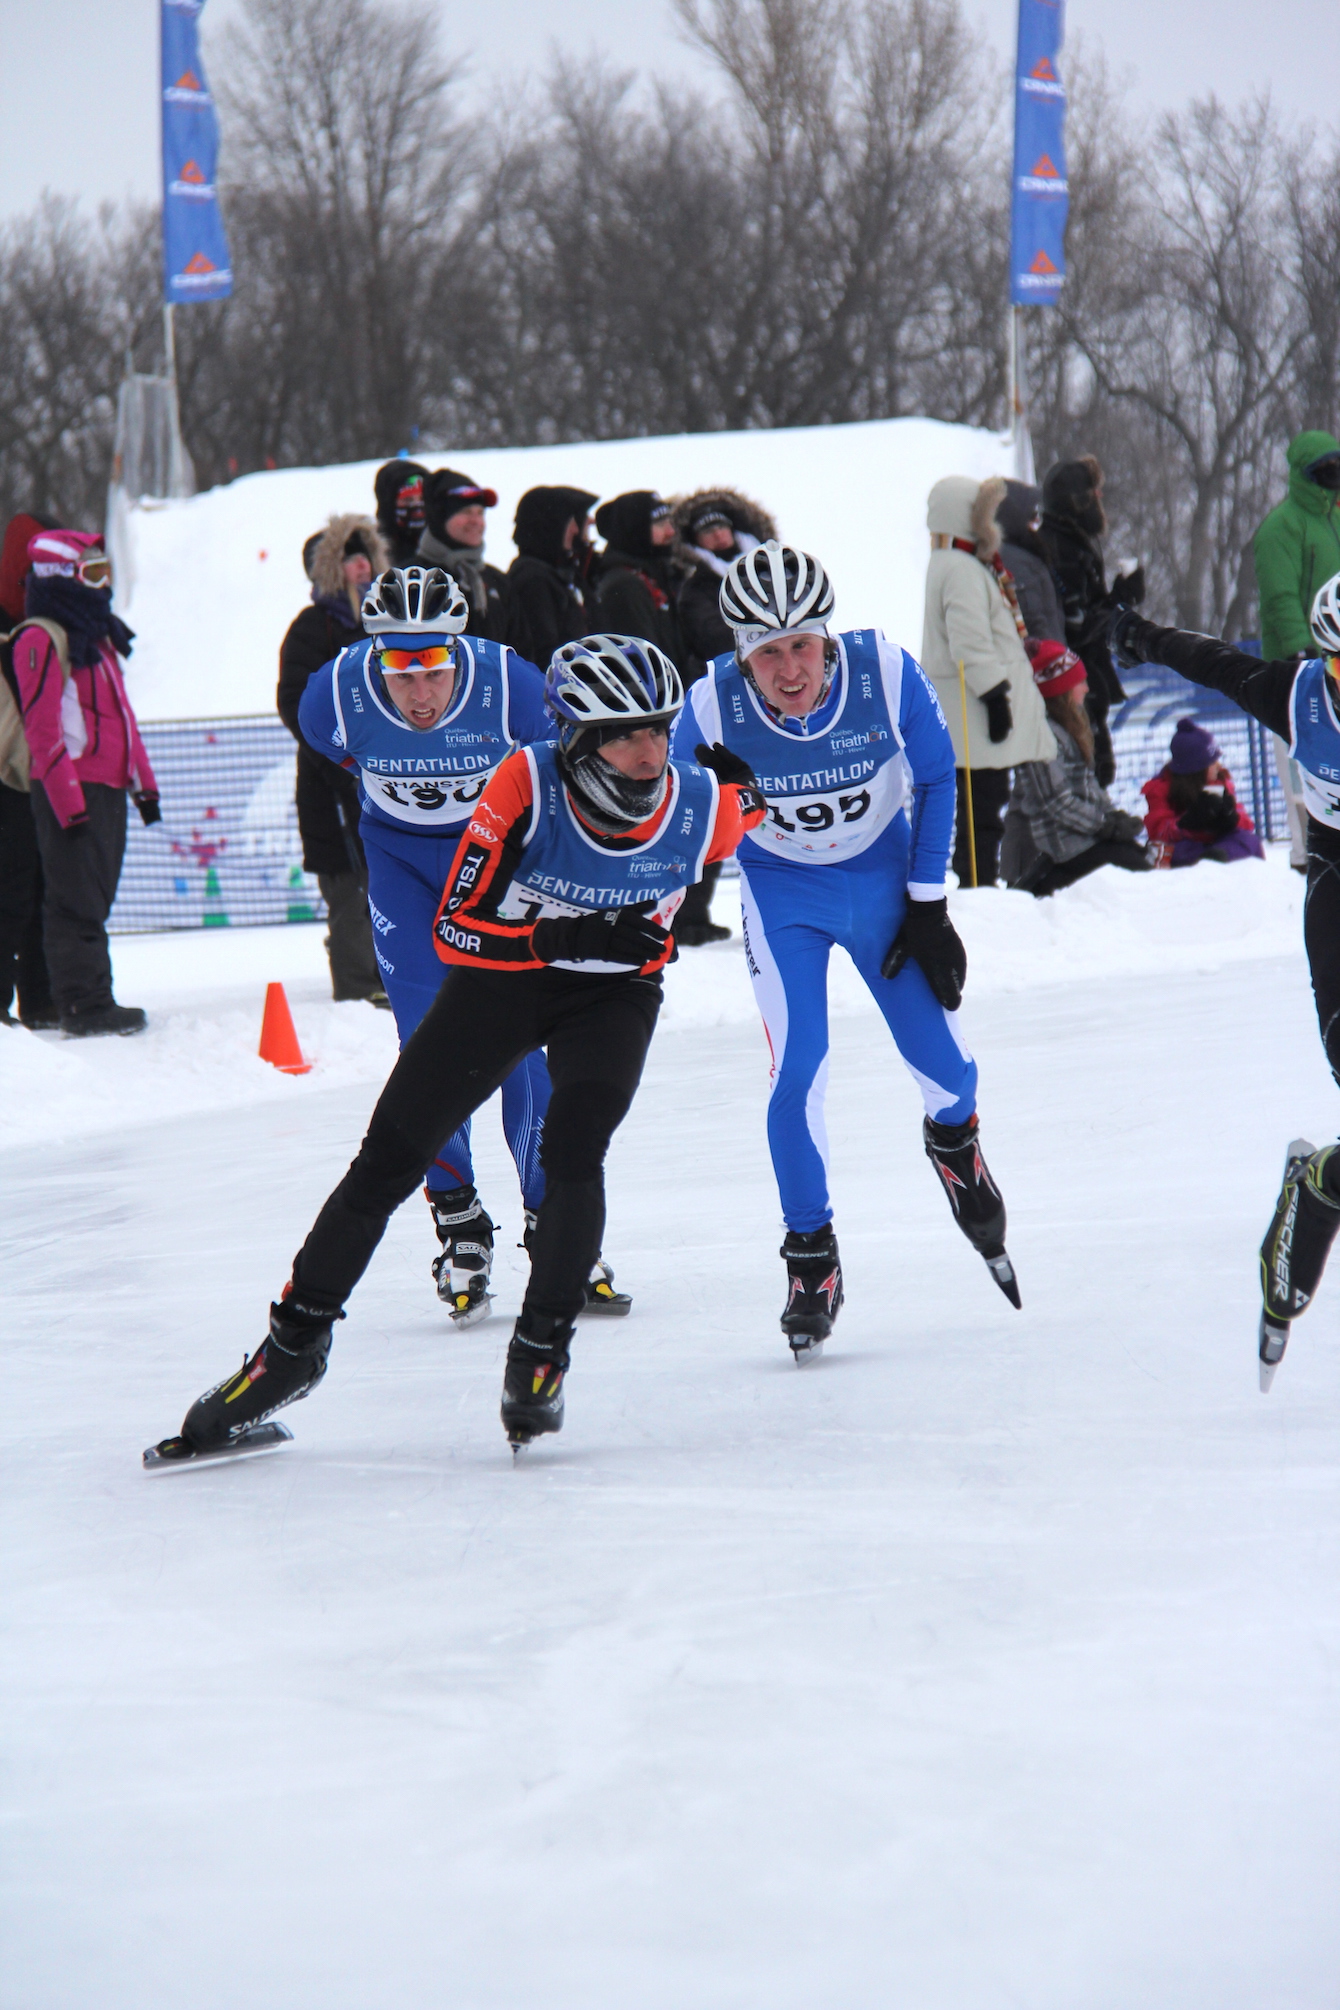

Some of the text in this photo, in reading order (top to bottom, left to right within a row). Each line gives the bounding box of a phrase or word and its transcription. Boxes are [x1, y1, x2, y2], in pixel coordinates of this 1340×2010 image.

[351, 686, 365, 713] ÉLITE
[482, 685, 493, 708] 2015
[860, 673, 872, 699] 2015
[732, 694, 746, 724] ÉLITE
[1310, 696, 1319, 724] ÉLITE
[829, 728, 854, 738] Québec
[830, 729, 888, 751] triathlon
[366, 755, 491, 773] PENTATHLON
[756, 760, 875, 792] PENTATHLON
[473, 822, 494, 841] TSL
[681, 807, 695, 836] 2015
[456, 854, 485, 894] TSL
[1274, 1183, 1301, 1302] FISCHER
